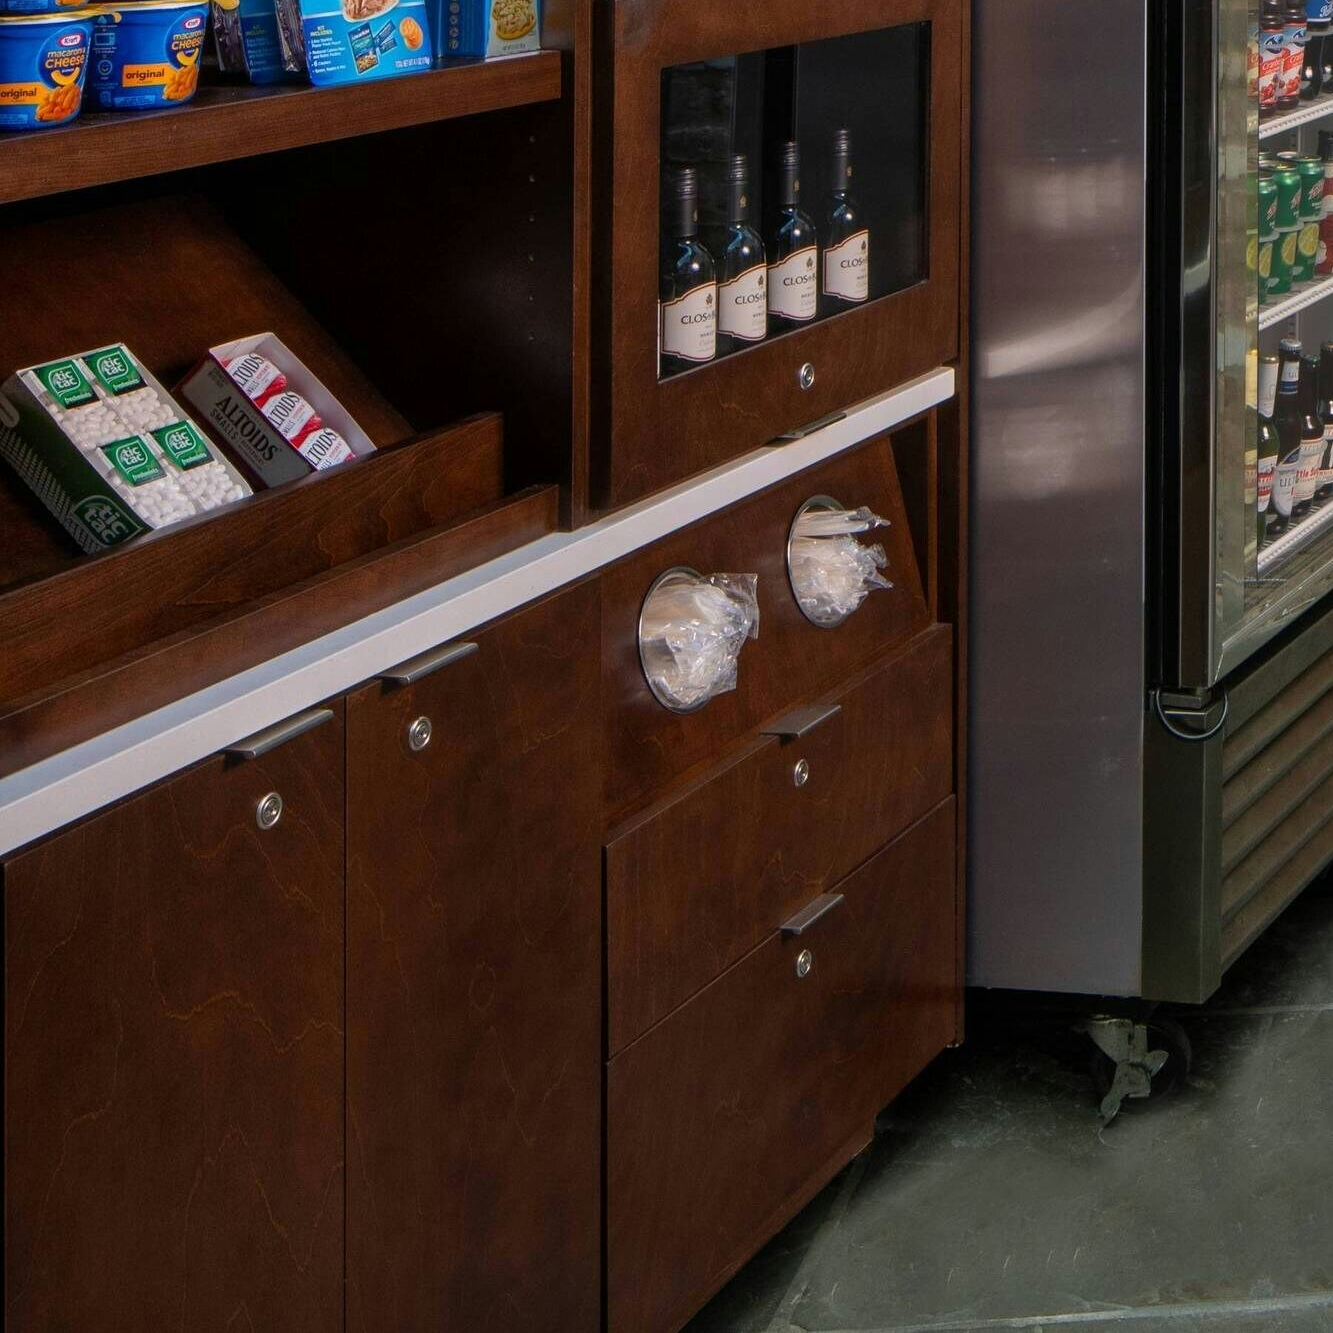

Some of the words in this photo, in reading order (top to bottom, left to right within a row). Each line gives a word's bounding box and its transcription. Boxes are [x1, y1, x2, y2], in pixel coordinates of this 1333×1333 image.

[126, 69, 165, 81] original
[0, 88, 37, 100] original
[840, 257, 864, 269] CLOS
[783, 275, 808, 287] CLOS
[735, 293, 760, 305] CLOS
[681, 312, 708, 325] CLOS
[103, 356, 120, 367] tic
[105, 364, 127, 376] tac
[233, 354, 265, 387] LTOIDS
[55, 370, 72, 383] tic
[57, 377, 78, 389] tac
[210, 409, 239, 440] SMALLS
[215, 396, 279, 461] ALTOIDS
[172, 430, 188, 442] tic
[174, 437, 193, 450] tac
[306, 429, 338, 467] LTOIDS
[123, 445, 139, 458] tic
[125, 453, 146, 465] tac
